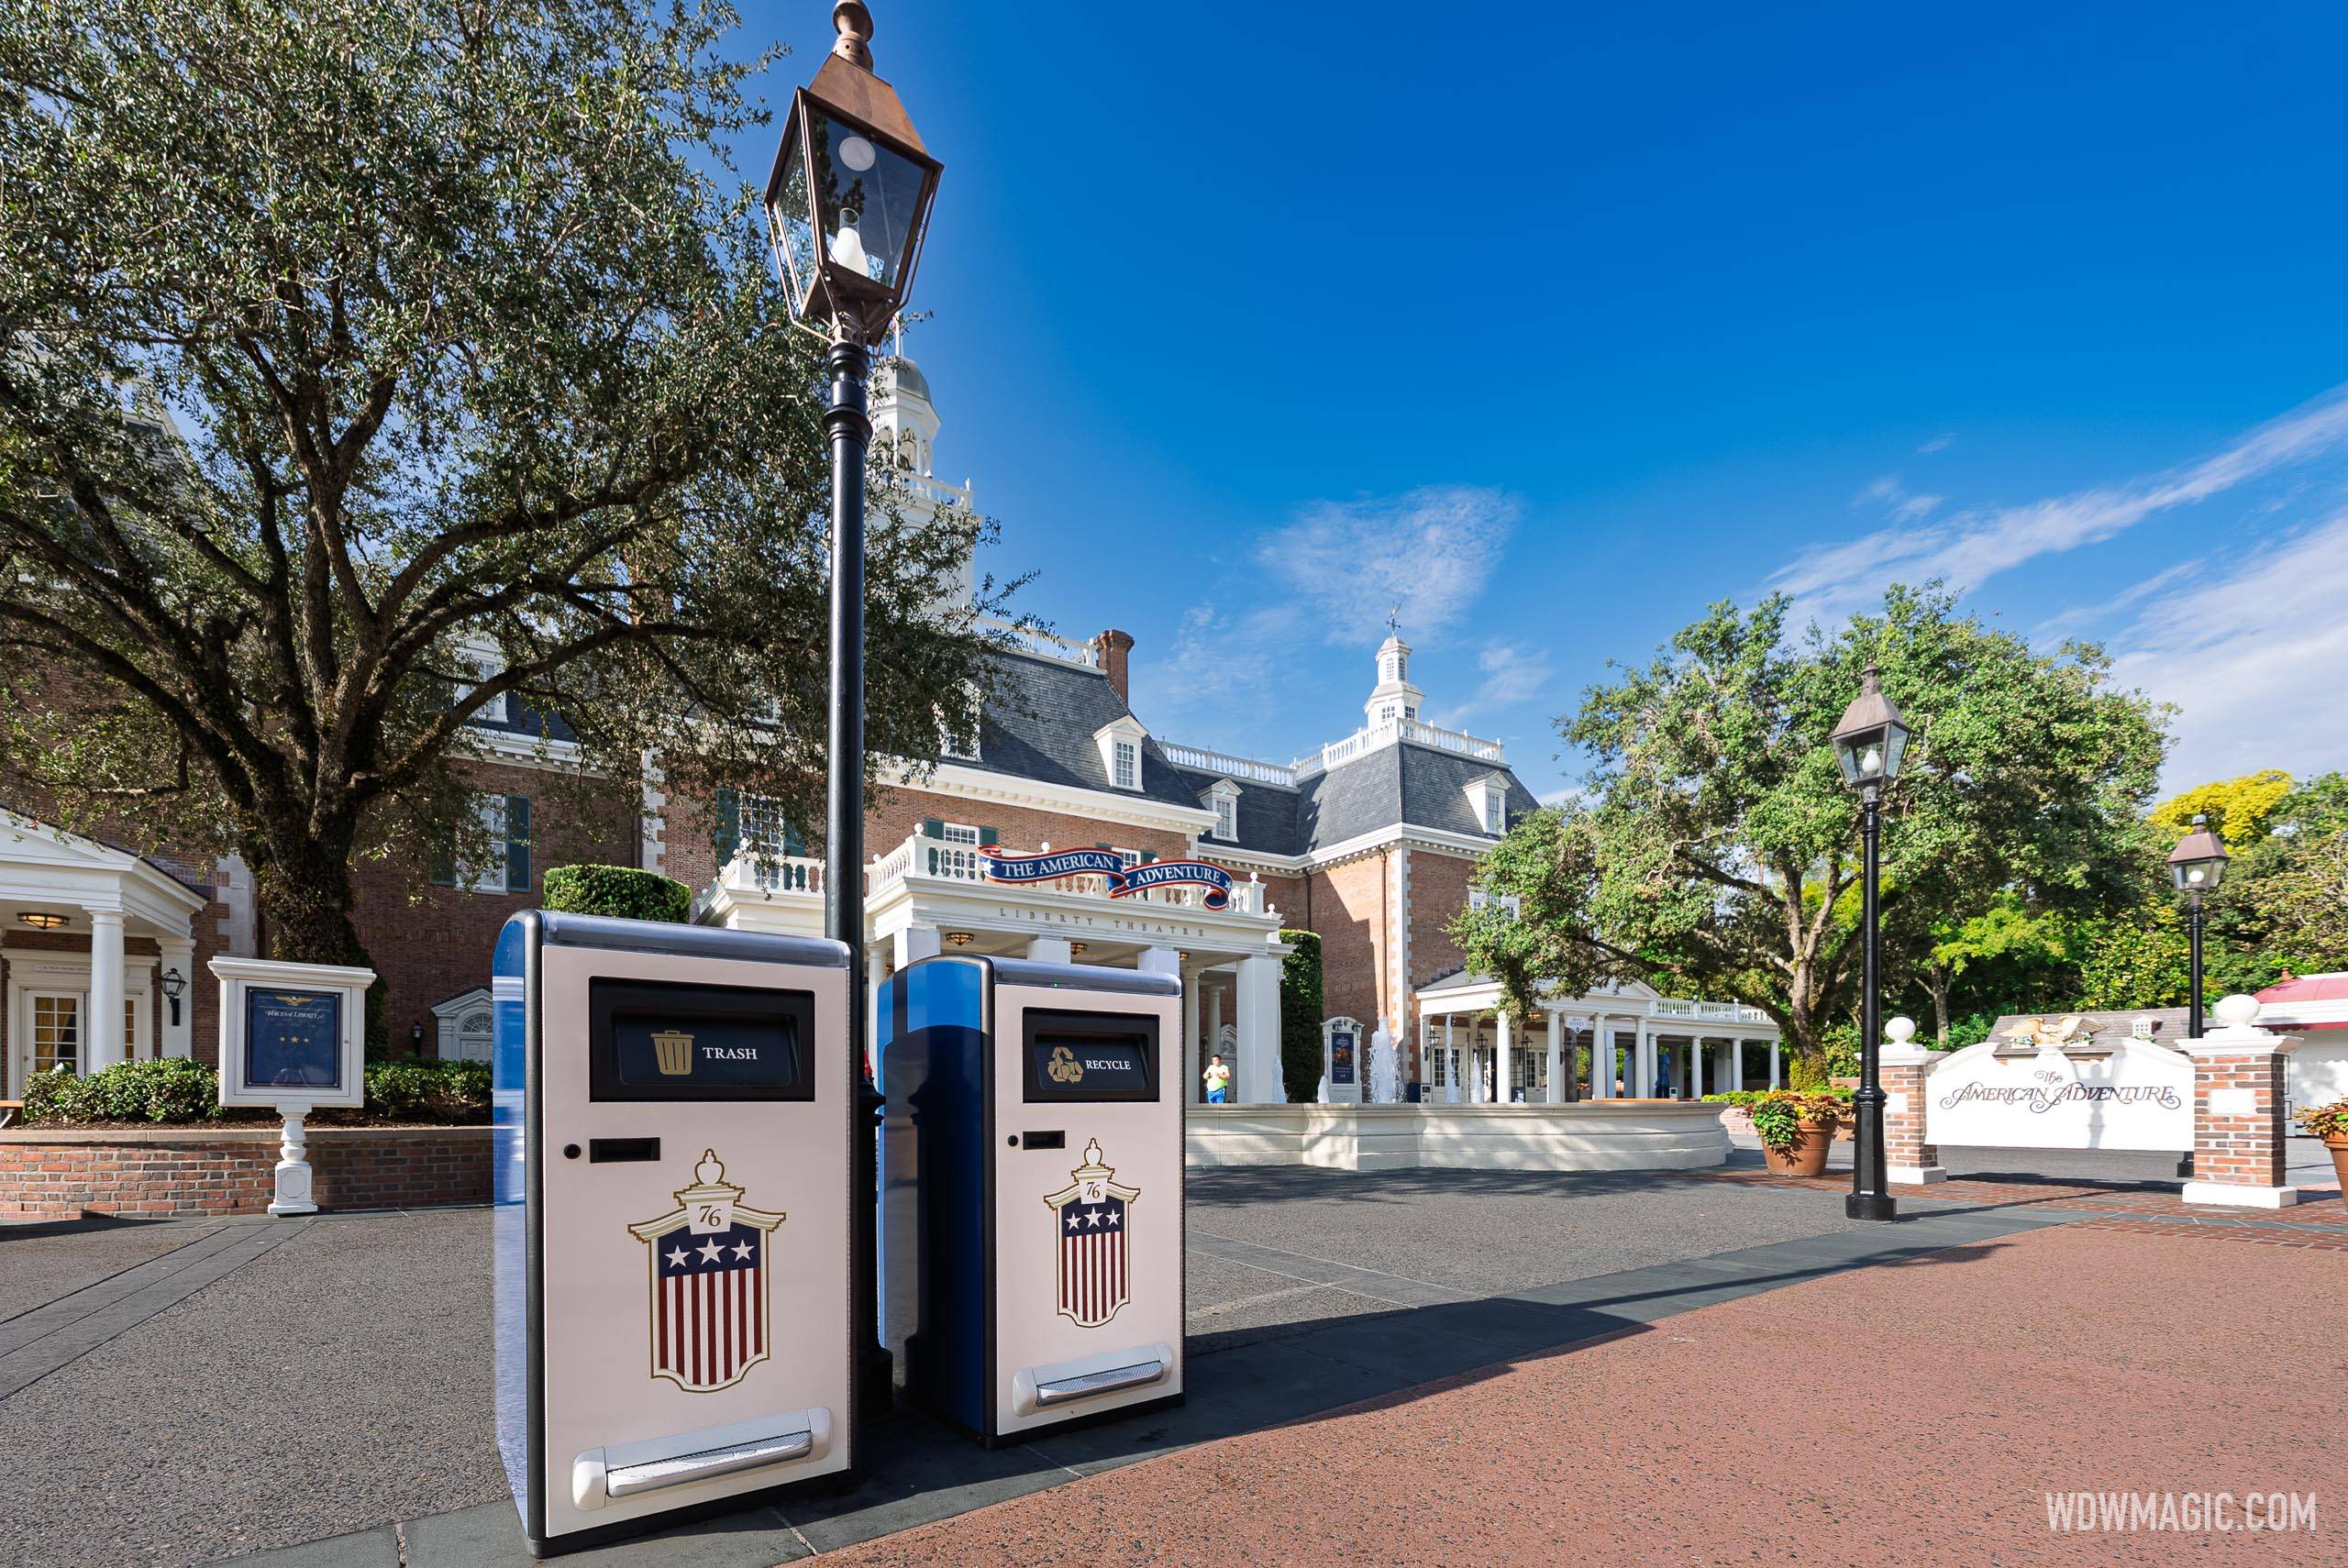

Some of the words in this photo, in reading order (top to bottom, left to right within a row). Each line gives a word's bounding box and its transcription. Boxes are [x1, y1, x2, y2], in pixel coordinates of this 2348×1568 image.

[1002, 863, 1035, 877] THE
[1038, 854, 1114, 873] AMERICAN
[1135, 866, 1221, 885] ADVENTURE
[1000, 908, 1094, 925] LIBERTY
[1114, 921, 1204, 937] THEATRE
[703, 1047, 758, 1060] TRASH
[1086, 1060, 1131, 1070] RECYCLE
[2034, 1070, 2063, 1083] The
[1940, 1081, 2061, 1110] AMERICAN
[2030, 1081, 2181, 1113] ADVENTURE
[1086, 1181, 1101, 1198] 76
[699, 1205, 721, 1227] 76
